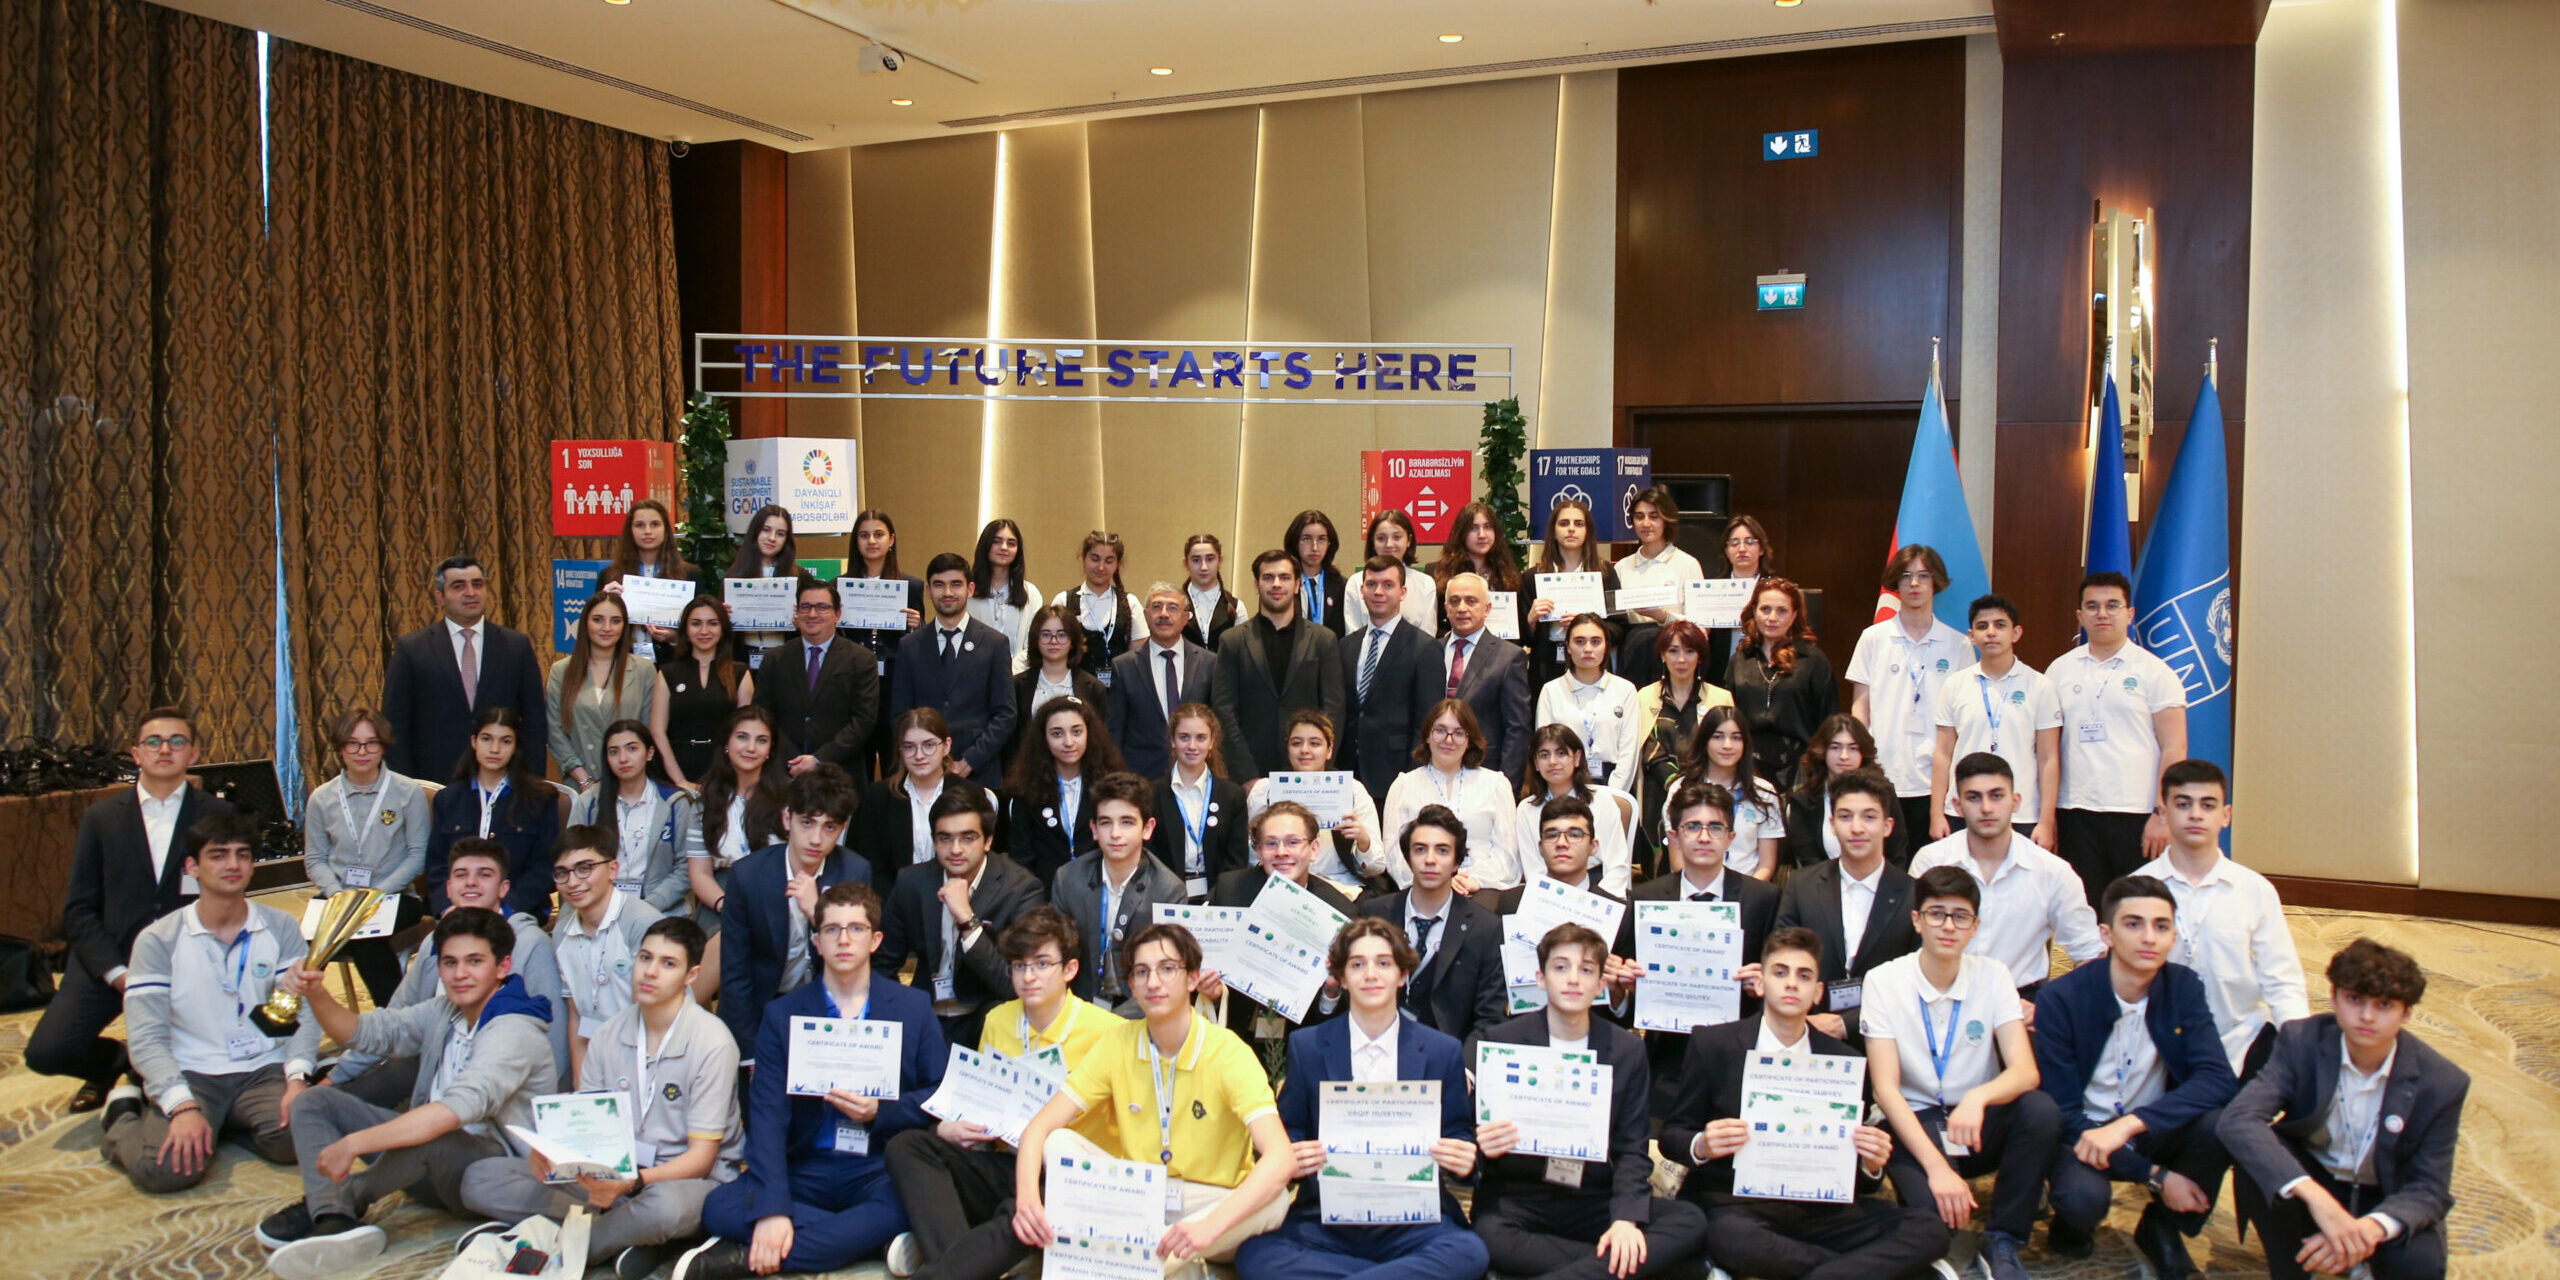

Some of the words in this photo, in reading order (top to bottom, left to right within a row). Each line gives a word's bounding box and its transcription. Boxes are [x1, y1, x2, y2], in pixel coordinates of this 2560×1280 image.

[734, 345, 842, 384] THE
[865, 346, 1083, 386] FUTURE
[1106, 348, 1312, 389] STARTS
[1335, 352, 1477, 391] HERE
[562, 448, 569, 468] 1
[577, 446, 623, 458] YOXSULLUĞA
[578, 460, 592, 469] SON
[1537, 456, 1551, 476] 17
[1555, 455, 1600, 465] PARTNERSHIPS
[1617, 455, 1625, 475] 17
[1388, 457, 1406, 478] 10
[1409, 469, 1451, 478] AZALDILMASI
[1555, 466, 1568, 476] FOR
[1568, 466, 1579, 476] THE
[1580, 466, 1600, 476] GOALS
[731, 476, 772, 487] SUSTAINABLE
[731, 487, 772, 497] DEVELOPMENT
[794, 488, 841, 498] DAYANIQLI
[801, 498, 836, 510] İNKİŞAF
[556, 568, 565, 588] 14
